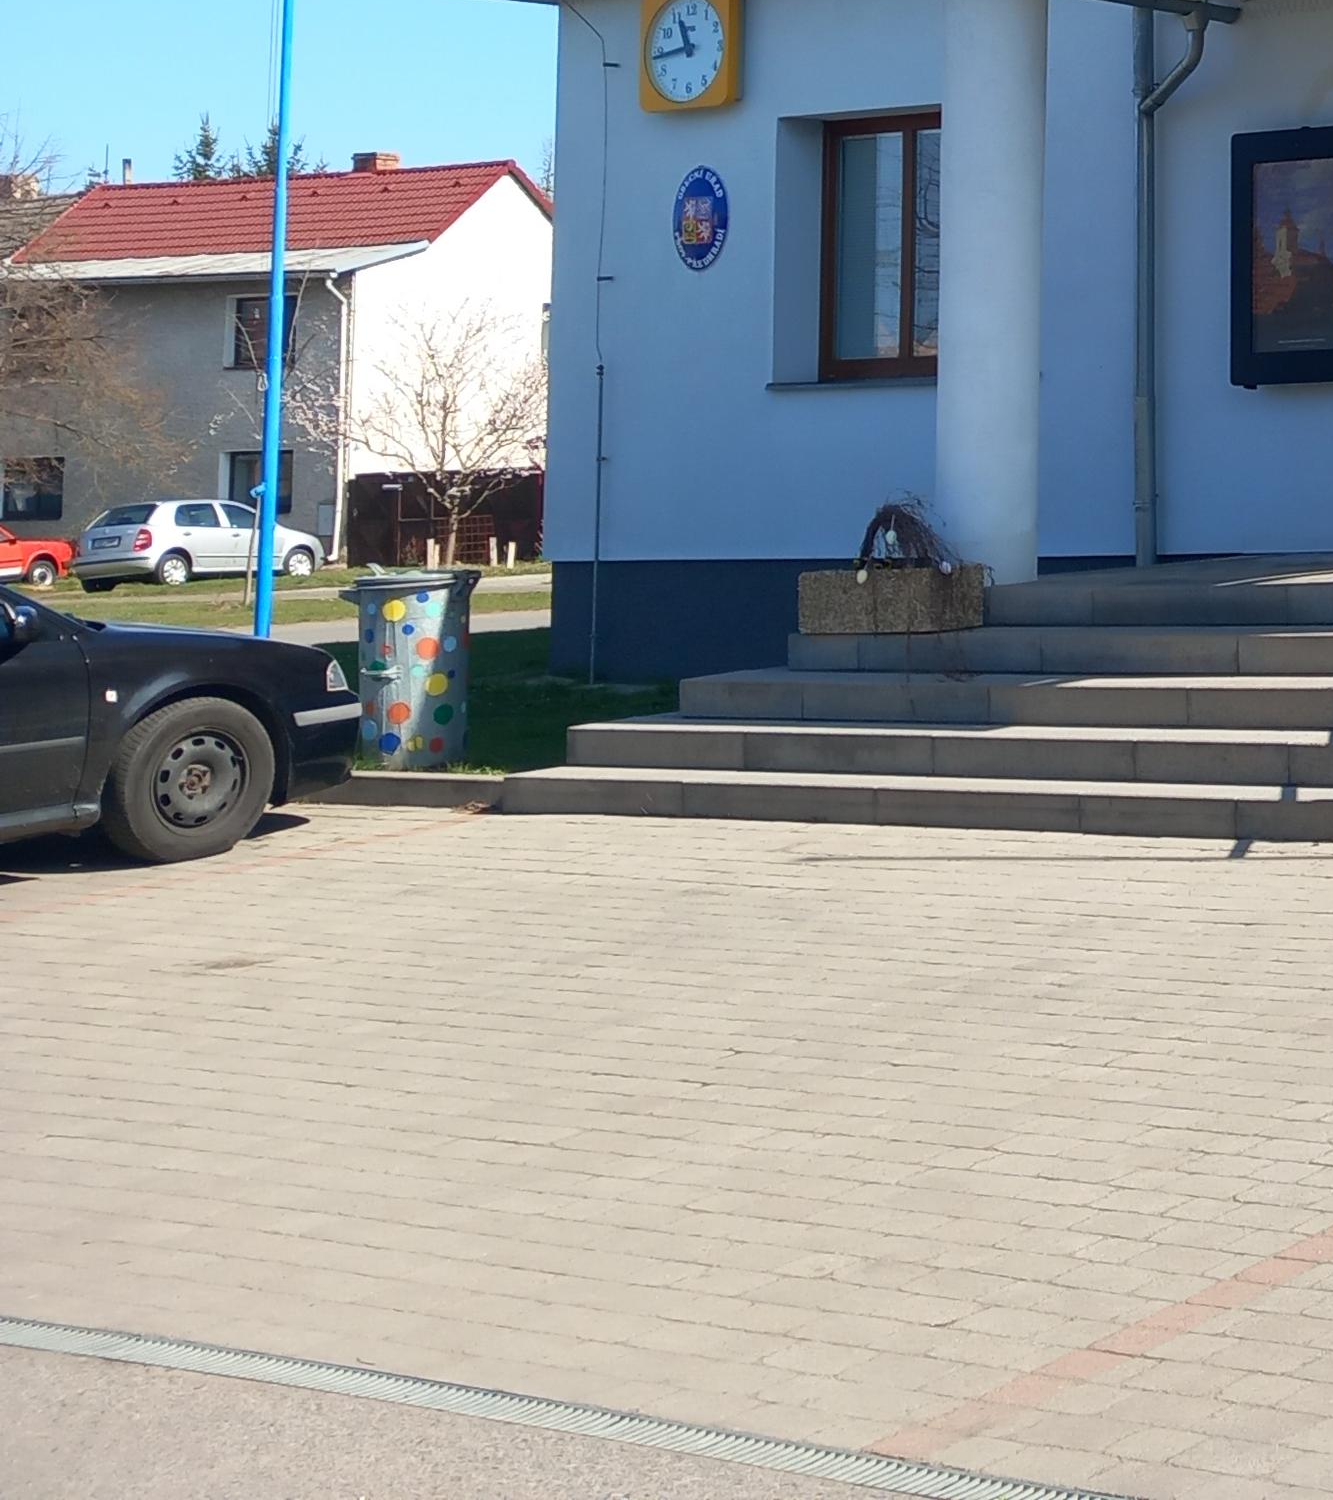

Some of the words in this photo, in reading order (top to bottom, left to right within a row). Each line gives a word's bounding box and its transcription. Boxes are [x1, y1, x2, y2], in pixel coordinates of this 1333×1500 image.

[686, 3, 697, 16] 12
[662, 27, 673, 39] 10
[712, 21, 719, 33] 2
[716, 40, 723, 52] 3
[660, 64, 667, 76] 8
[671, 78, 678, 90] 7
[701, 74, 707, 86] 5
[685, 82, 692, 93] 6
